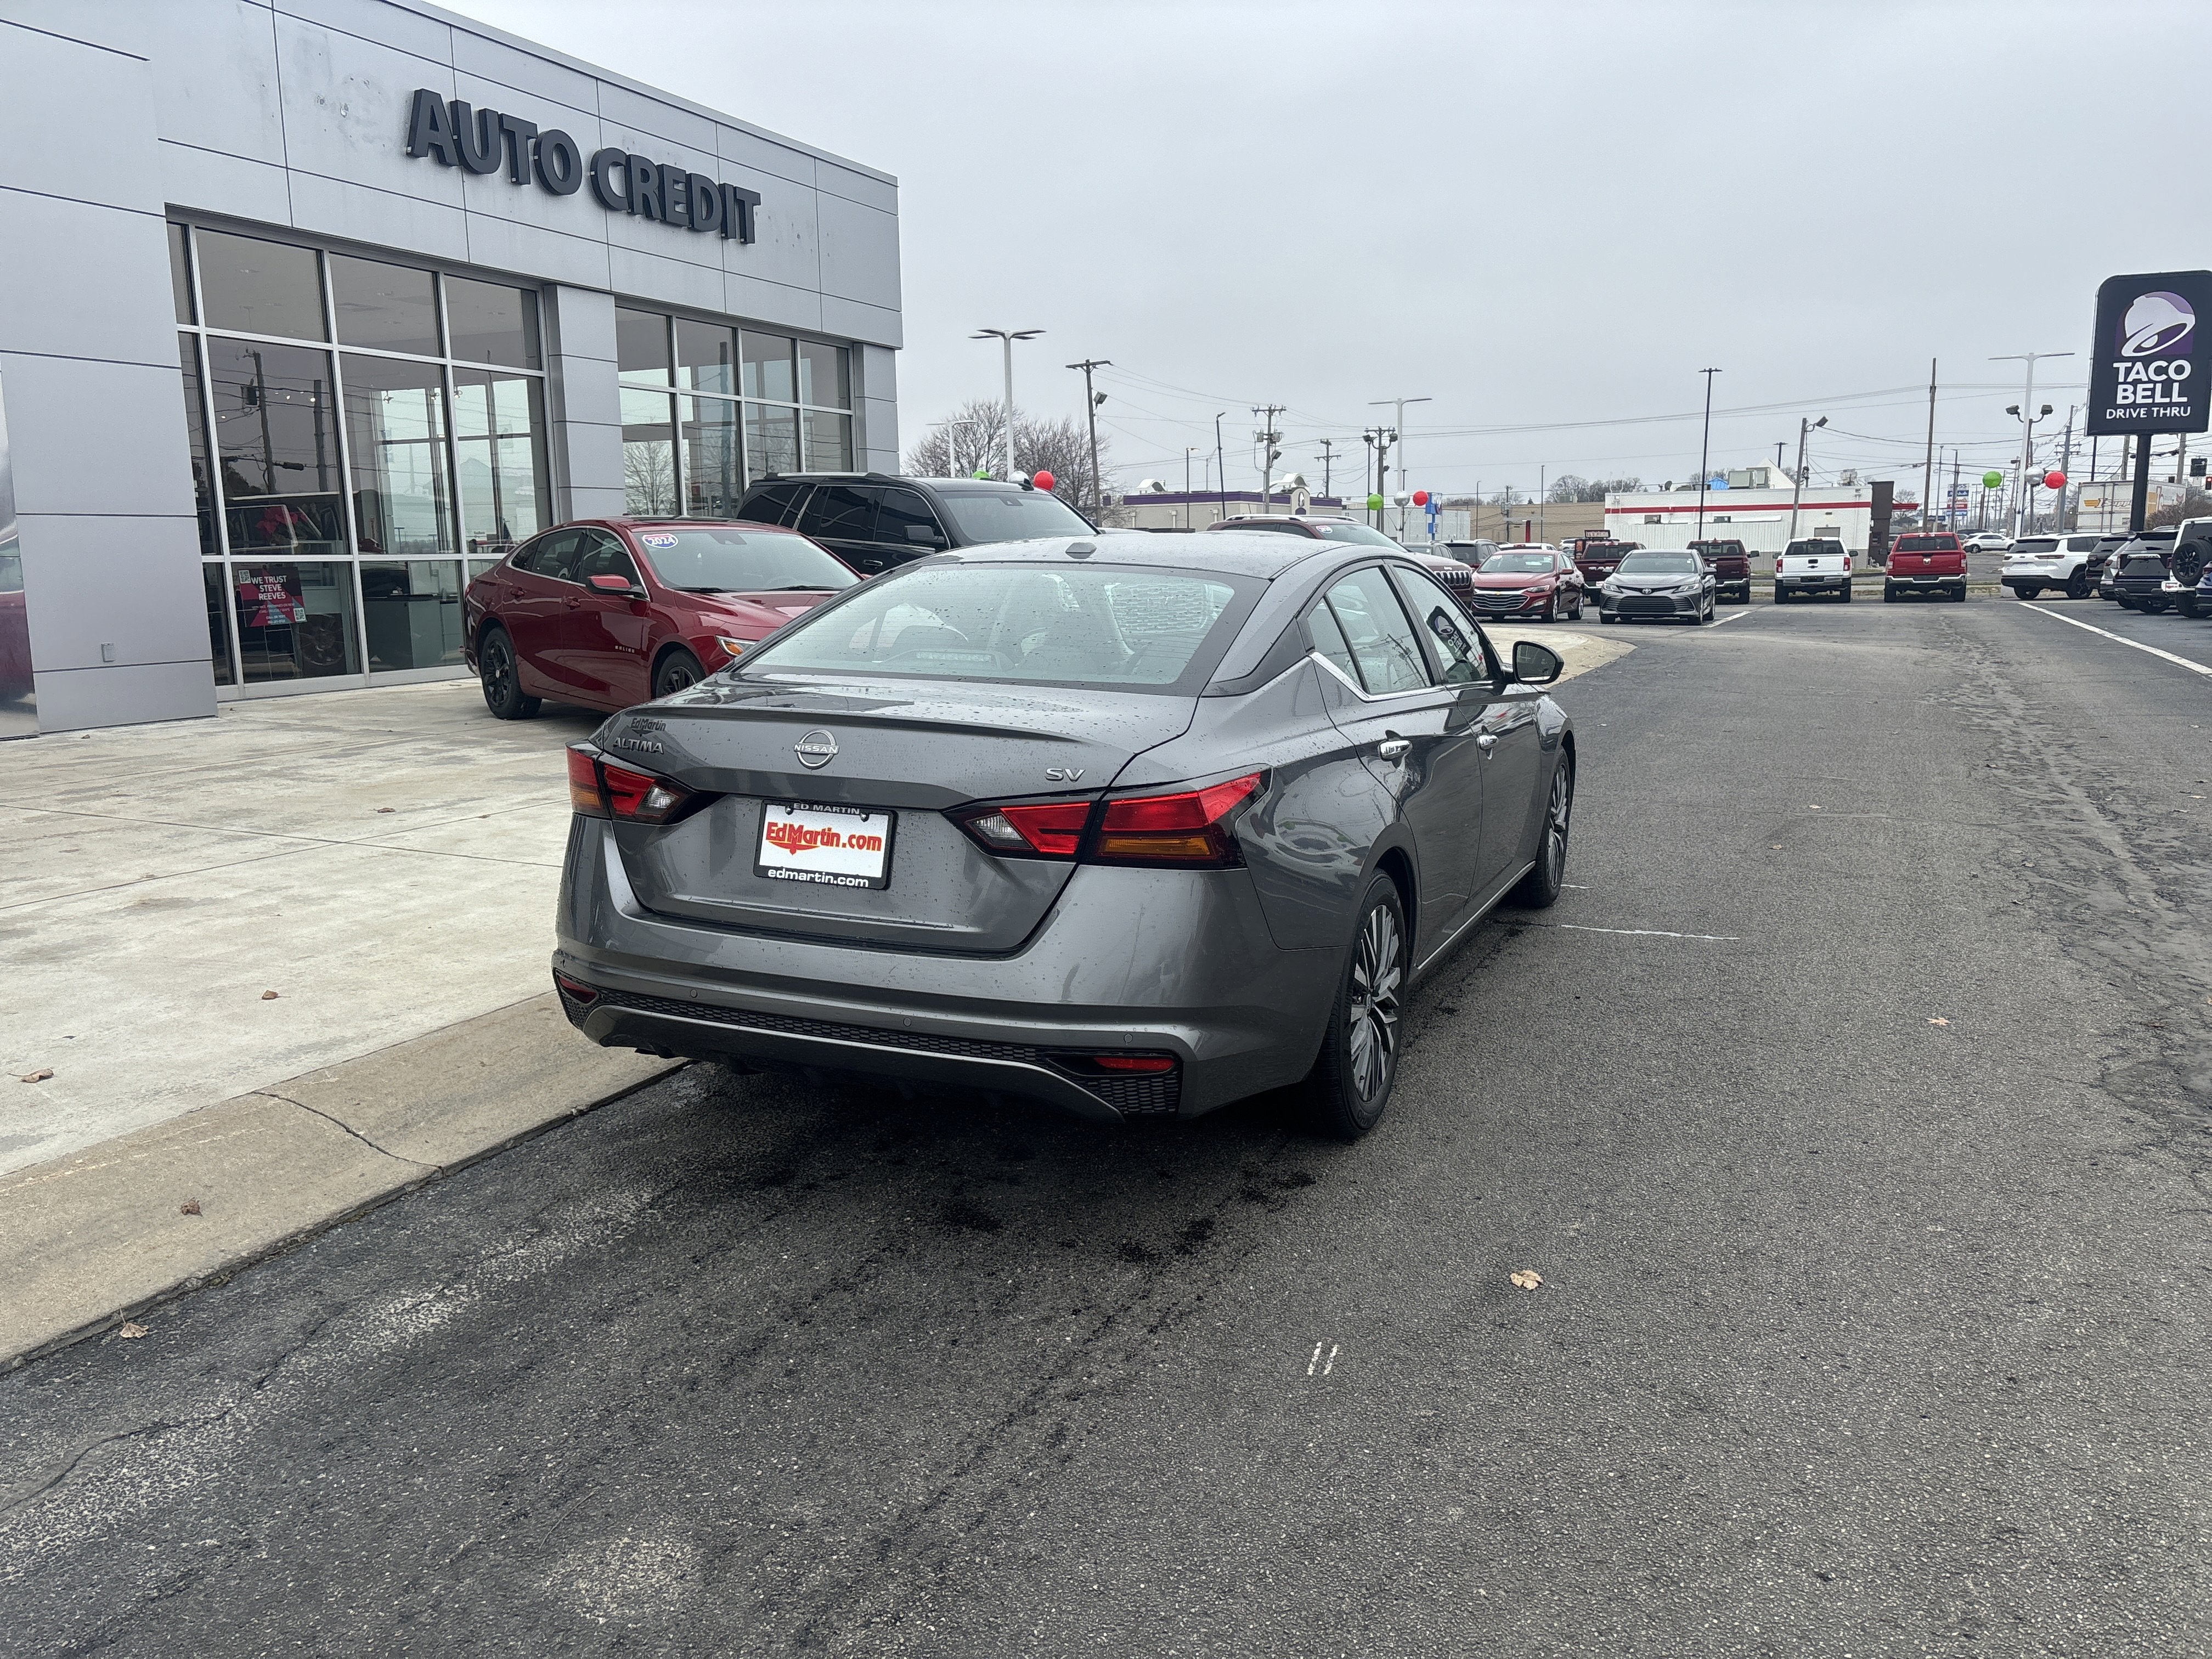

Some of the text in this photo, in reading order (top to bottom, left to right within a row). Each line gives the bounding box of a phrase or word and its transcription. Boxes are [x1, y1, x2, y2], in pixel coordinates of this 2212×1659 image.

[406, 88, 761, 244] AUTO CREDIT
[2113, 359, 2192, 382] TACO
[2117, 382, 2188, 404] BELL
[2106, 406, 2191, 419] DRIVE THRU
[648, 537, 675, 545] 2024
[259, 584, 282, 592] STEVE
[258, 592, 286, 600] REEVES
[630, 717, 666, 732] EdMartin
[613, 737, 664, 755] ALTIMA
[794, 744, 838, 753] NISSAN
[1044, 768, 1086, 783] SV
[812, 804, 860, 815] MARTIN
[765, 821, 882, 851] EdMartin.com
[768, 868, 868, 887] edmartin.com
